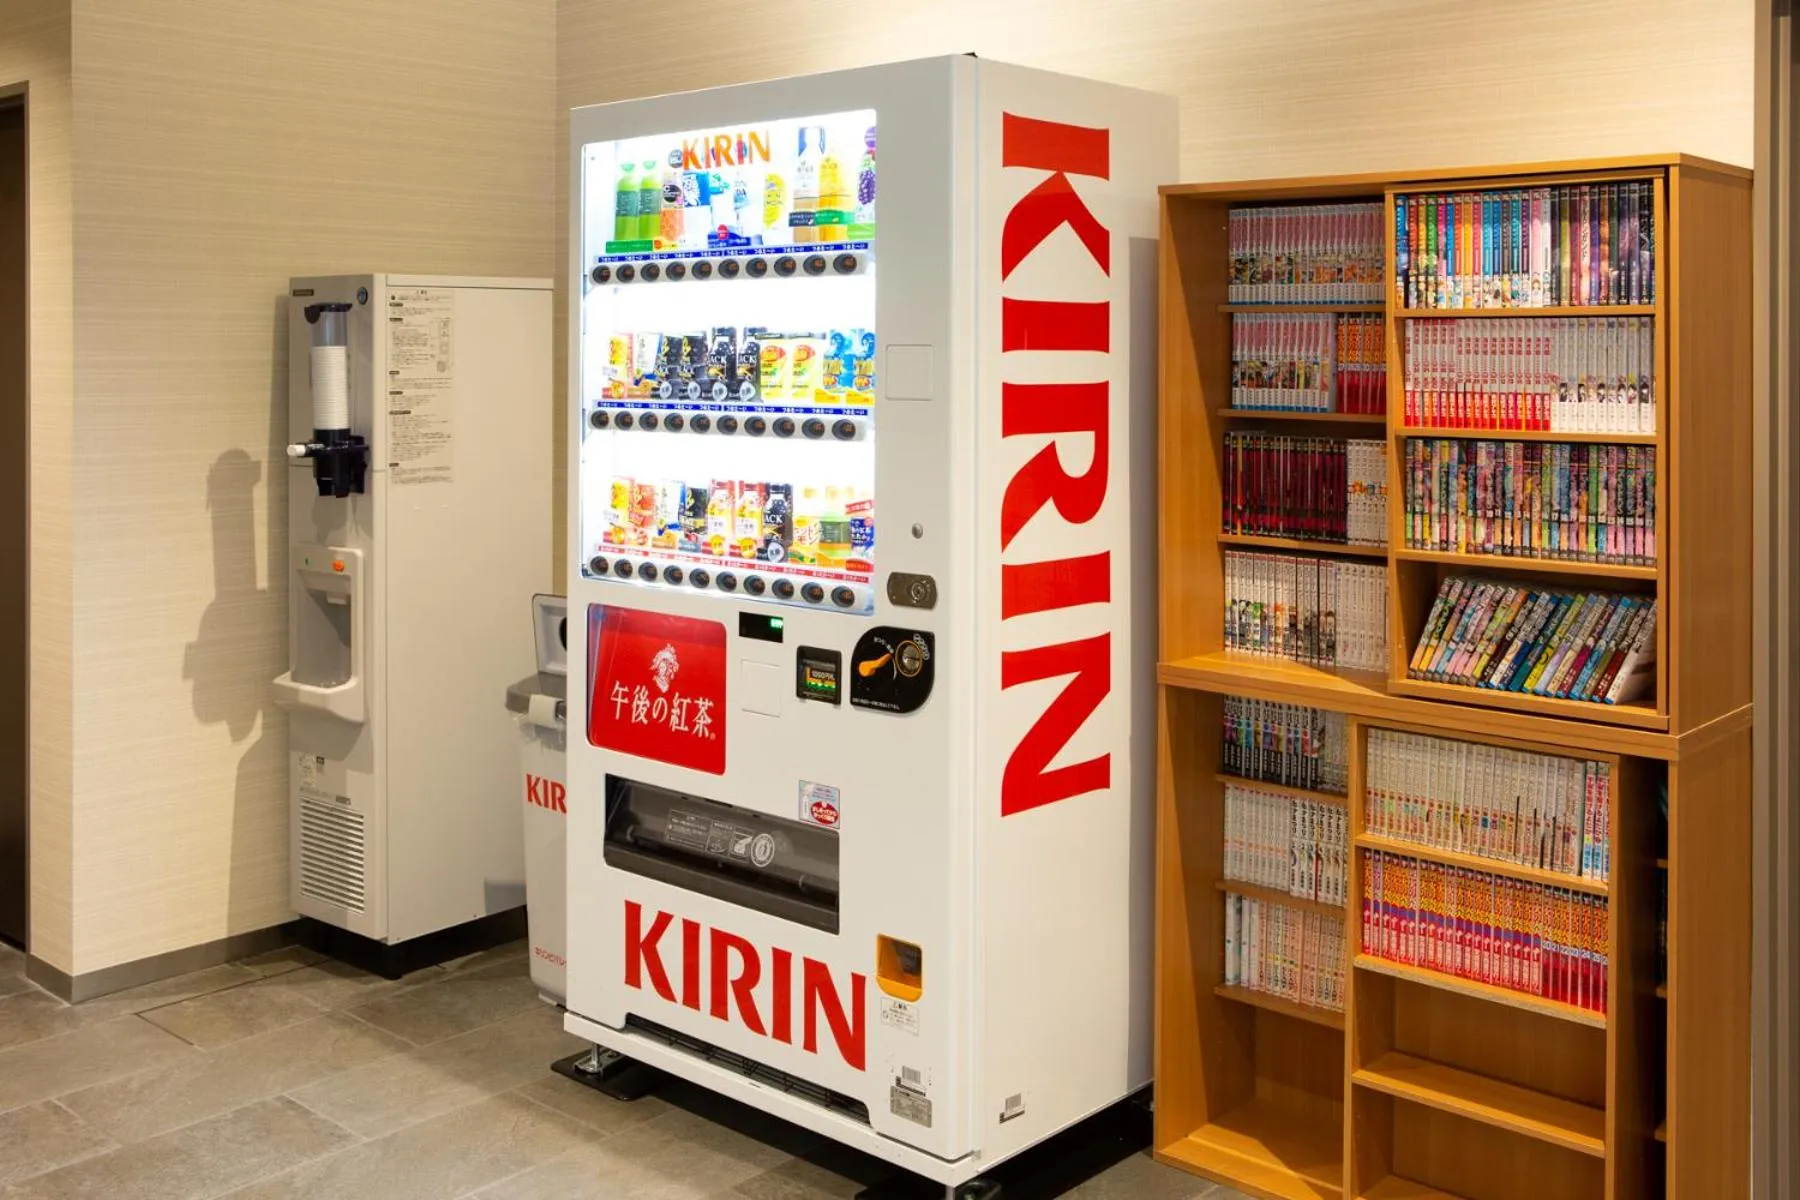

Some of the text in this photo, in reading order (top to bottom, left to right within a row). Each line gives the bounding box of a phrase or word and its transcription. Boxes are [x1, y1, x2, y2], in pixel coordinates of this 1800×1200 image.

[682, 131, 771, 171] KIRIN
[1001, 112, 1110, 817] KIRIN
[610, 680, 714, 738] 午後の紅茶
[526, 773, 567, 814] KIR
[624, 900, 867, 1072] KIRIN
